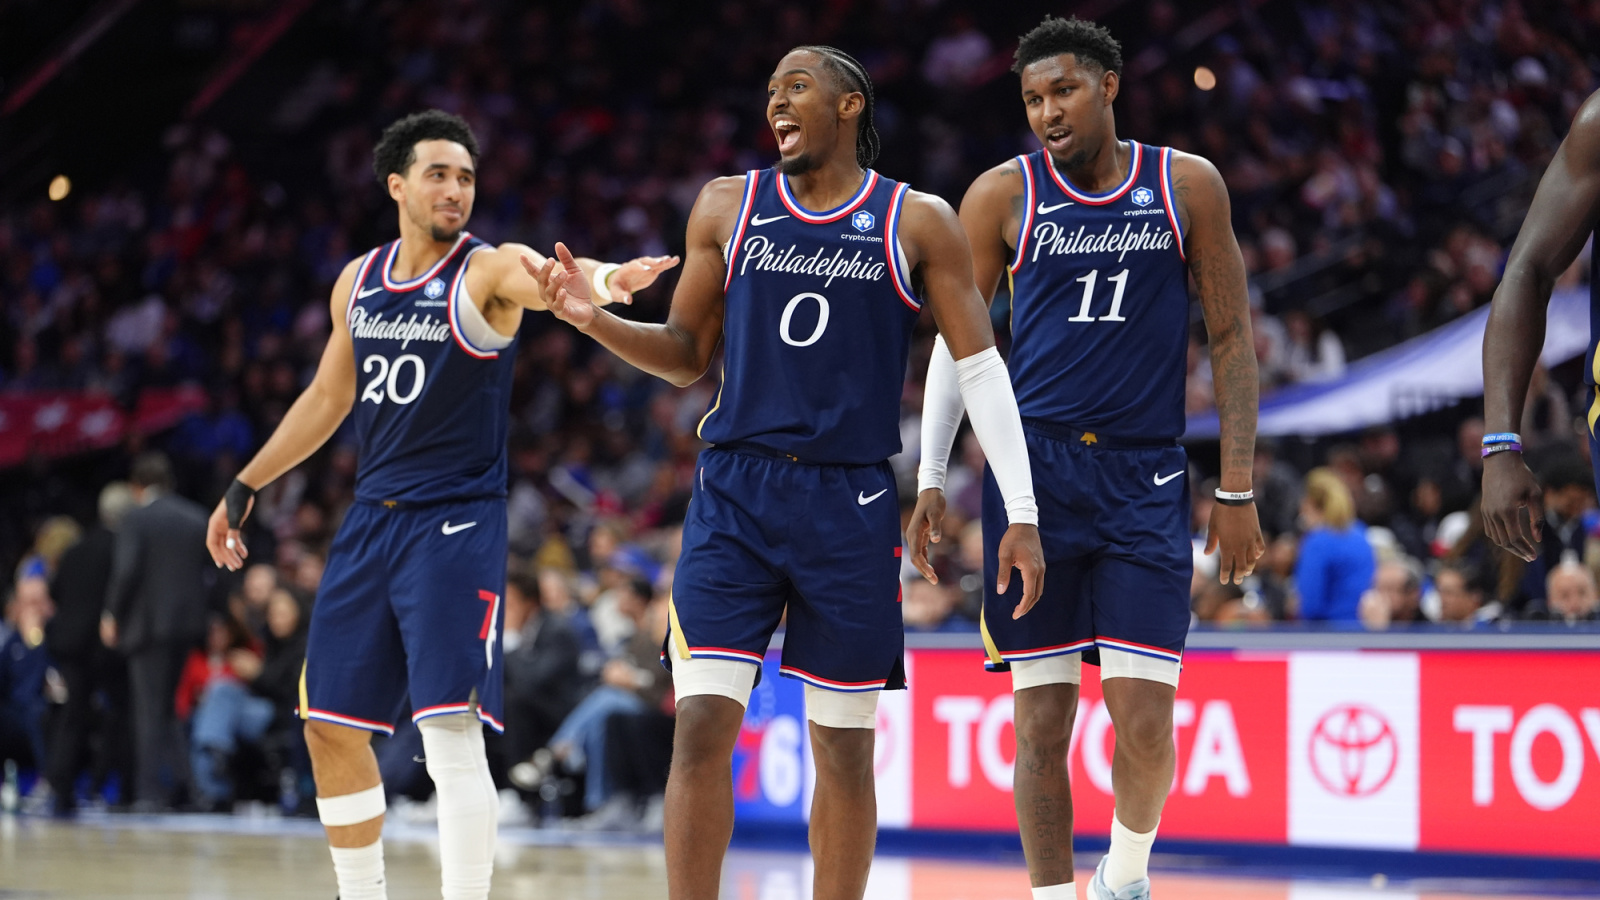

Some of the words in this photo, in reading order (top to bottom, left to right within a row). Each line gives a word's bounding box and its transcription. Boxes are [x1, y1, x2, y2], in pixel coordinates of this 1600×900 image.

[1124, 208, 1164, 216] crypto.com
[740, 235, 885, 288] Philadelphia
[840, 233, 883, 243] crypto.com
[1032, 222, 1172, 263] Philadelphia
[779, 292, 830, 347] 0
[1068, 268, 1129, 322] 11
[350, 305, 451, 350] Philadelphia
[360, 354, 426, 405] 20
[735, 714, 801, 808] 76
